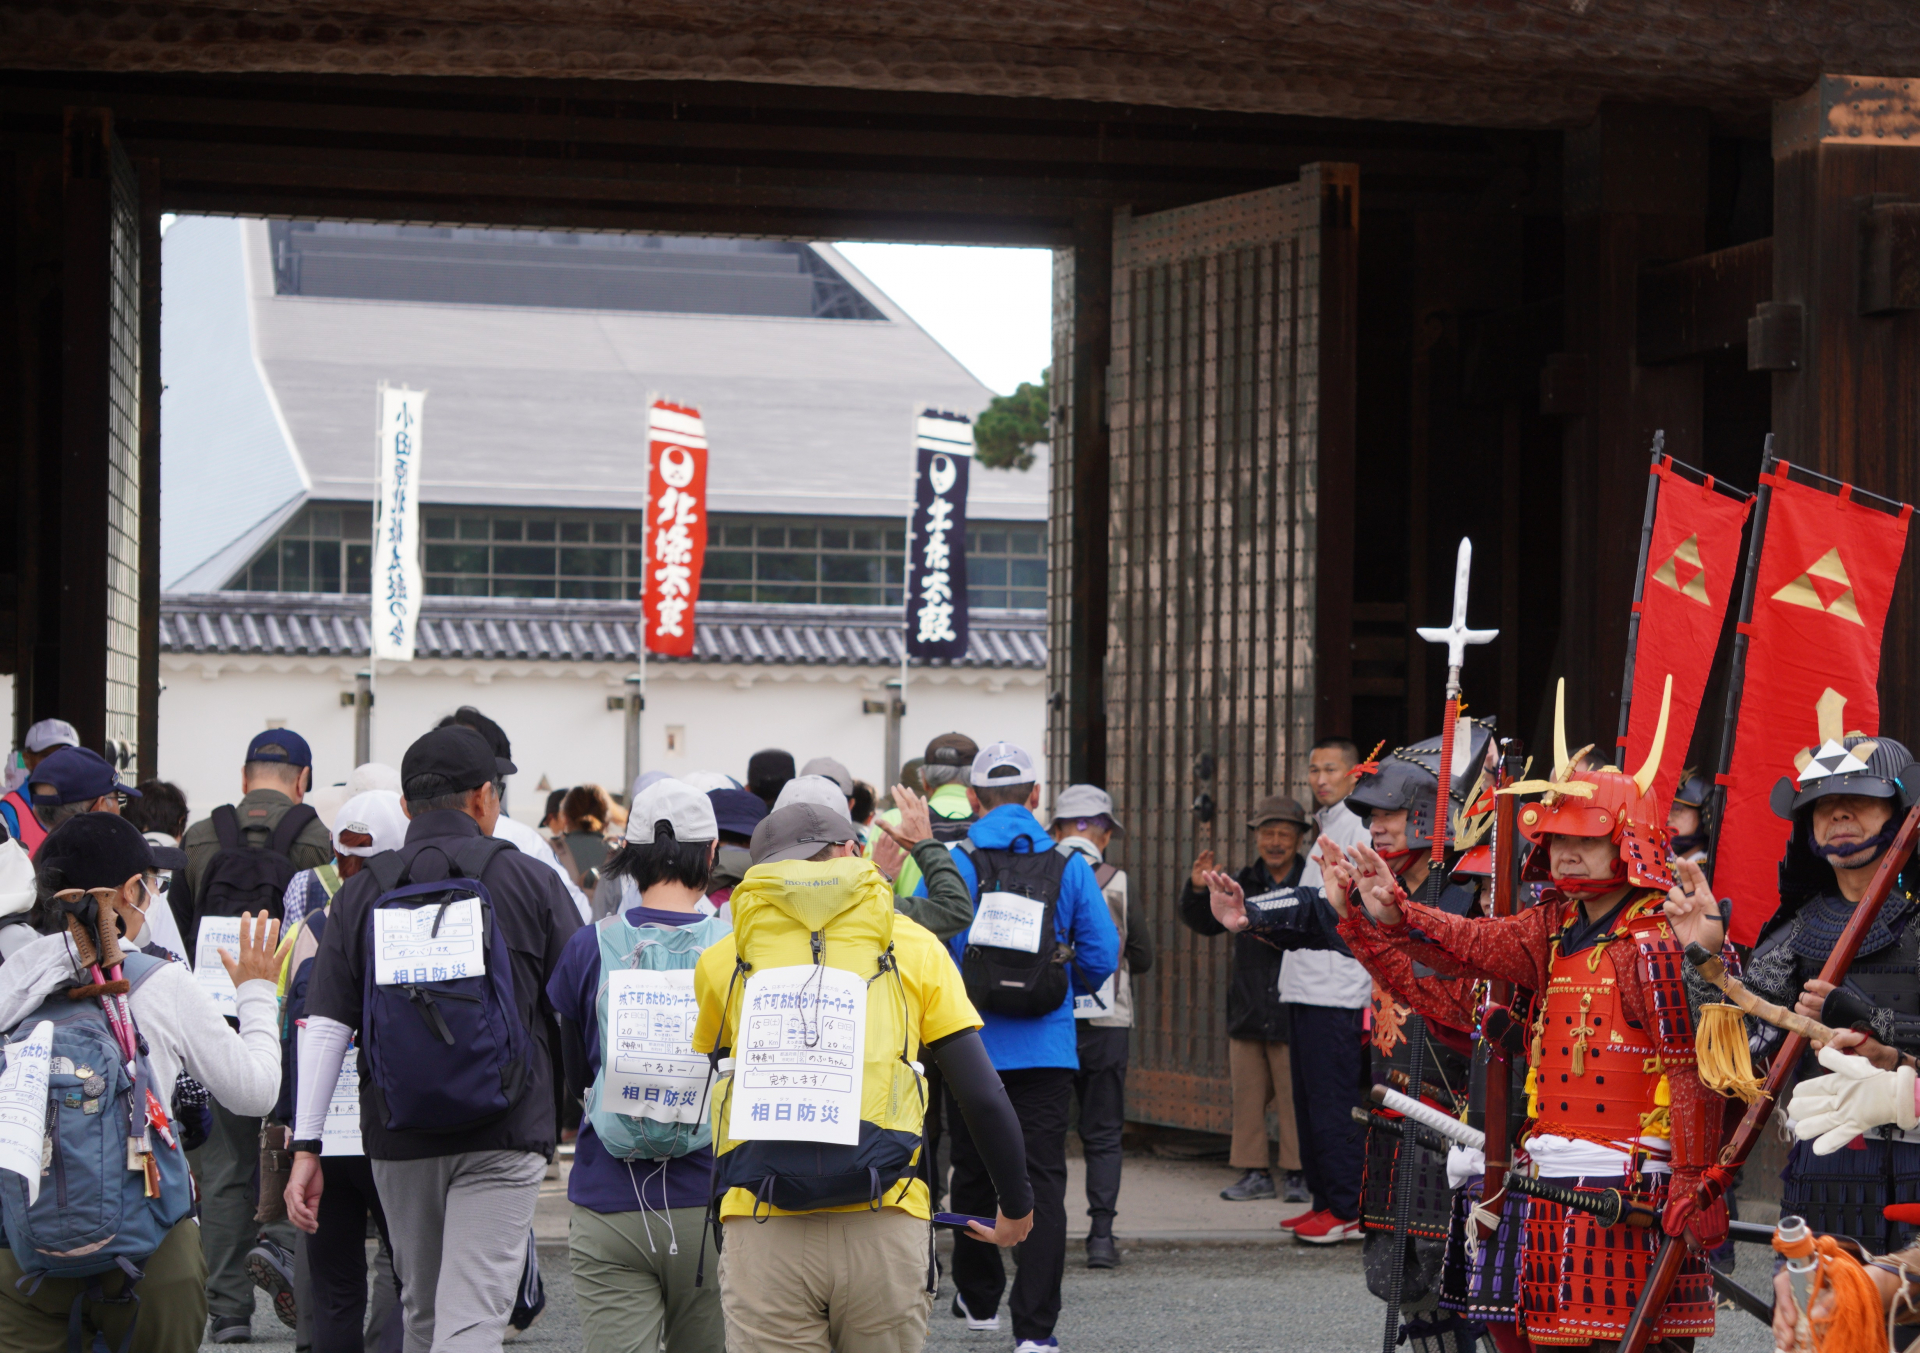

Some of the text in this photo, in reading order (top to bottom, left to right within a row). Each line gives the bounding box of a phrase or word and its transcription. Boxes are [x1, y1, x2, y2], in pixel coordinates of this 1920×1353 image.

[393, 962, 467, 984] 相日防災
[752, 991, 855, 1015] 城下町おだわらツーデーマーチ
[621, 1028, 632, 1036] 20
[753, 1040, 764, 1049] 20
[751, 1053, 775, 1063] 神奈川
[808, 1054, 848, 1067] のぶちゃん
[622, 1085, 697, 1107] 相日防災
[751, 1102, 839, 1124] 相日防災
